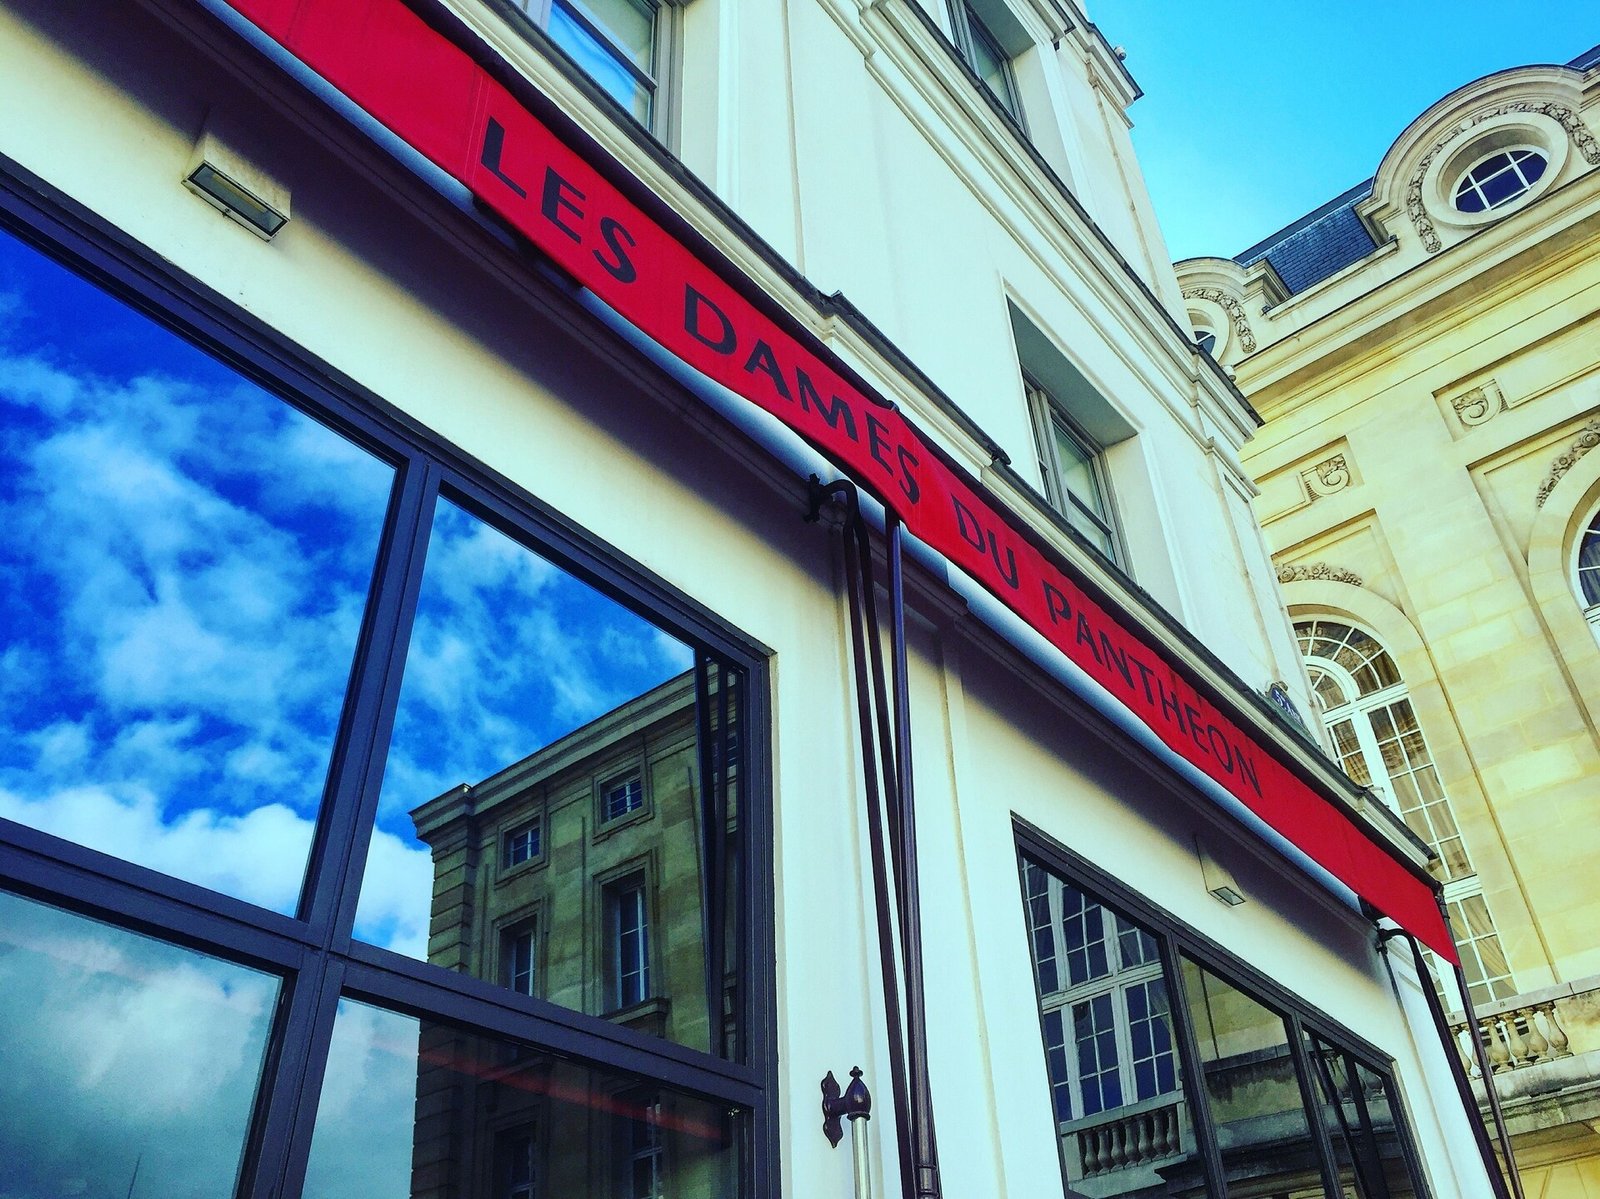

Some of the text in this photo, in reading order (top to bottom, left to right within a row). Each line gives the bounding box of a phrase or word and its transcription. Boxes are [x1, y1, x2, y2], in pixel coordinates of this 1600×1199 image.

[481, 116, 1263, 799] LES DAMES DU PANTHEON
